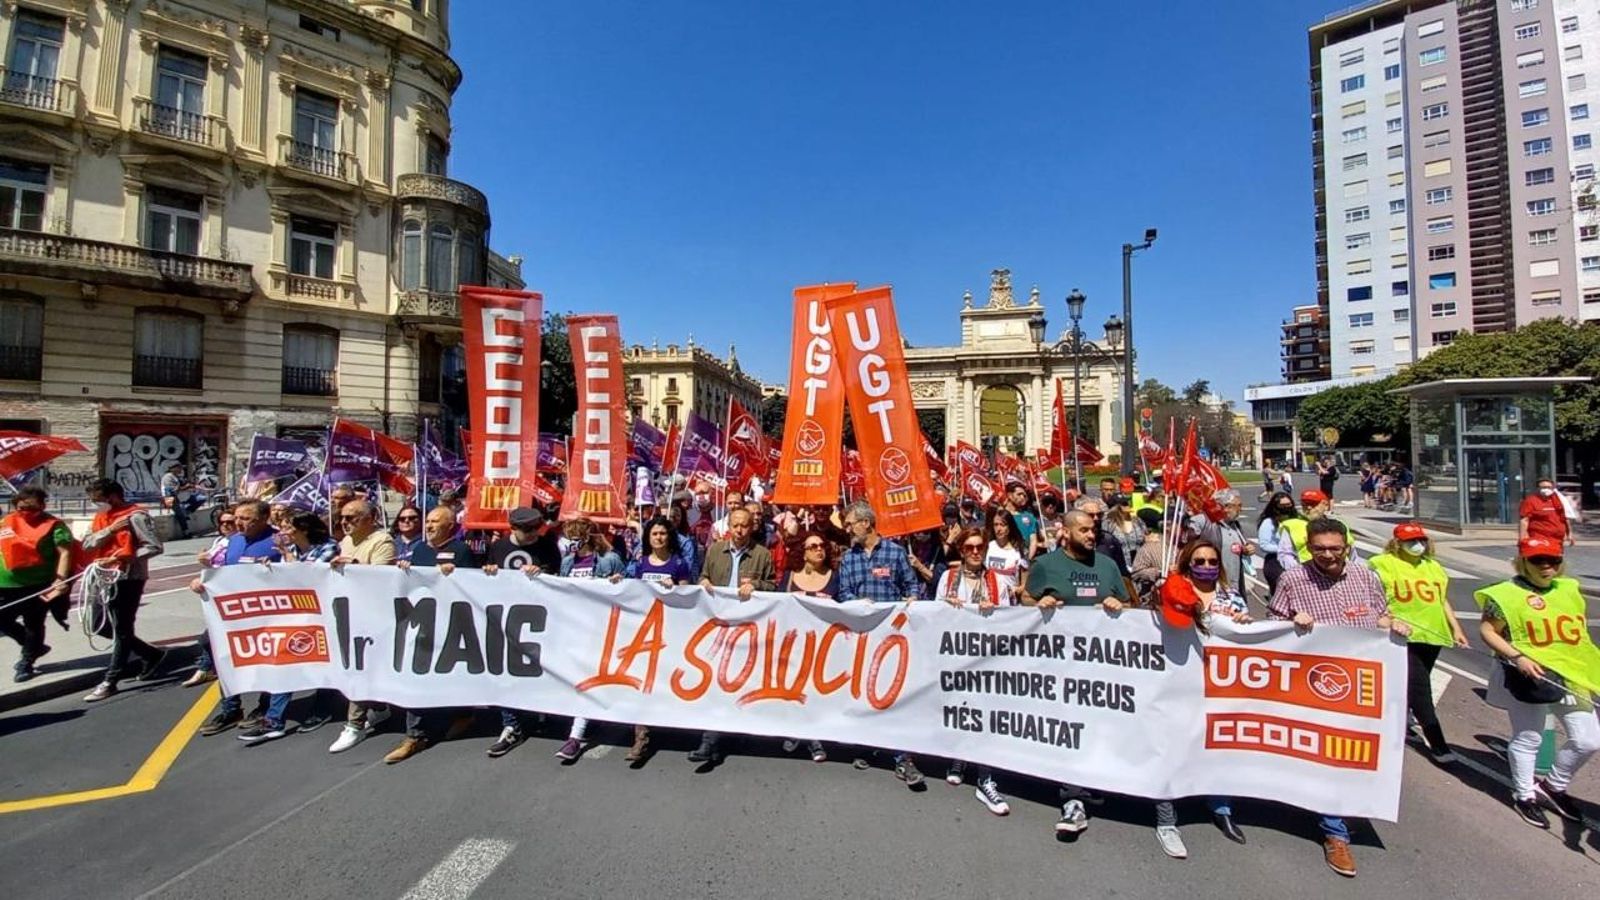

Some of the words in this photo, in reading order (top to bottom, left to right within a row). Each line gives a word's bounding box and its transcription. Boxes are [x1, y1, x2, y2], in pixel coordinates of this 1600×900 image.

[803, 301, 831, 416] UGT
[846, 308, 894, 443] UGT
[481, 308, 525, 479] CCOO
[580, 326, 610, 484] CCOO
[221, 596, 292, 615] CCOO
[233, 632, 287, 657] UGT
[393, 597, 548, 677] MAIG
[575, 598, 667, 695] LA
[670, 612, 909, 711] SOLUCIÓ
[939, 631, 1066, 660] AUGMENTAR
[1073, 636, 1165, 671] SALARIS
[940, 670, 1056, 701] CONTINDRE
[1063, 678, 1135, 713] PREUS
[1209, 654, 1300, 691] UGT
[943, 702, 983, 732] MÉS
[990, 710, 1084, 749] IGUALTAT
[1213, 720, 1319, 754] CCOO
